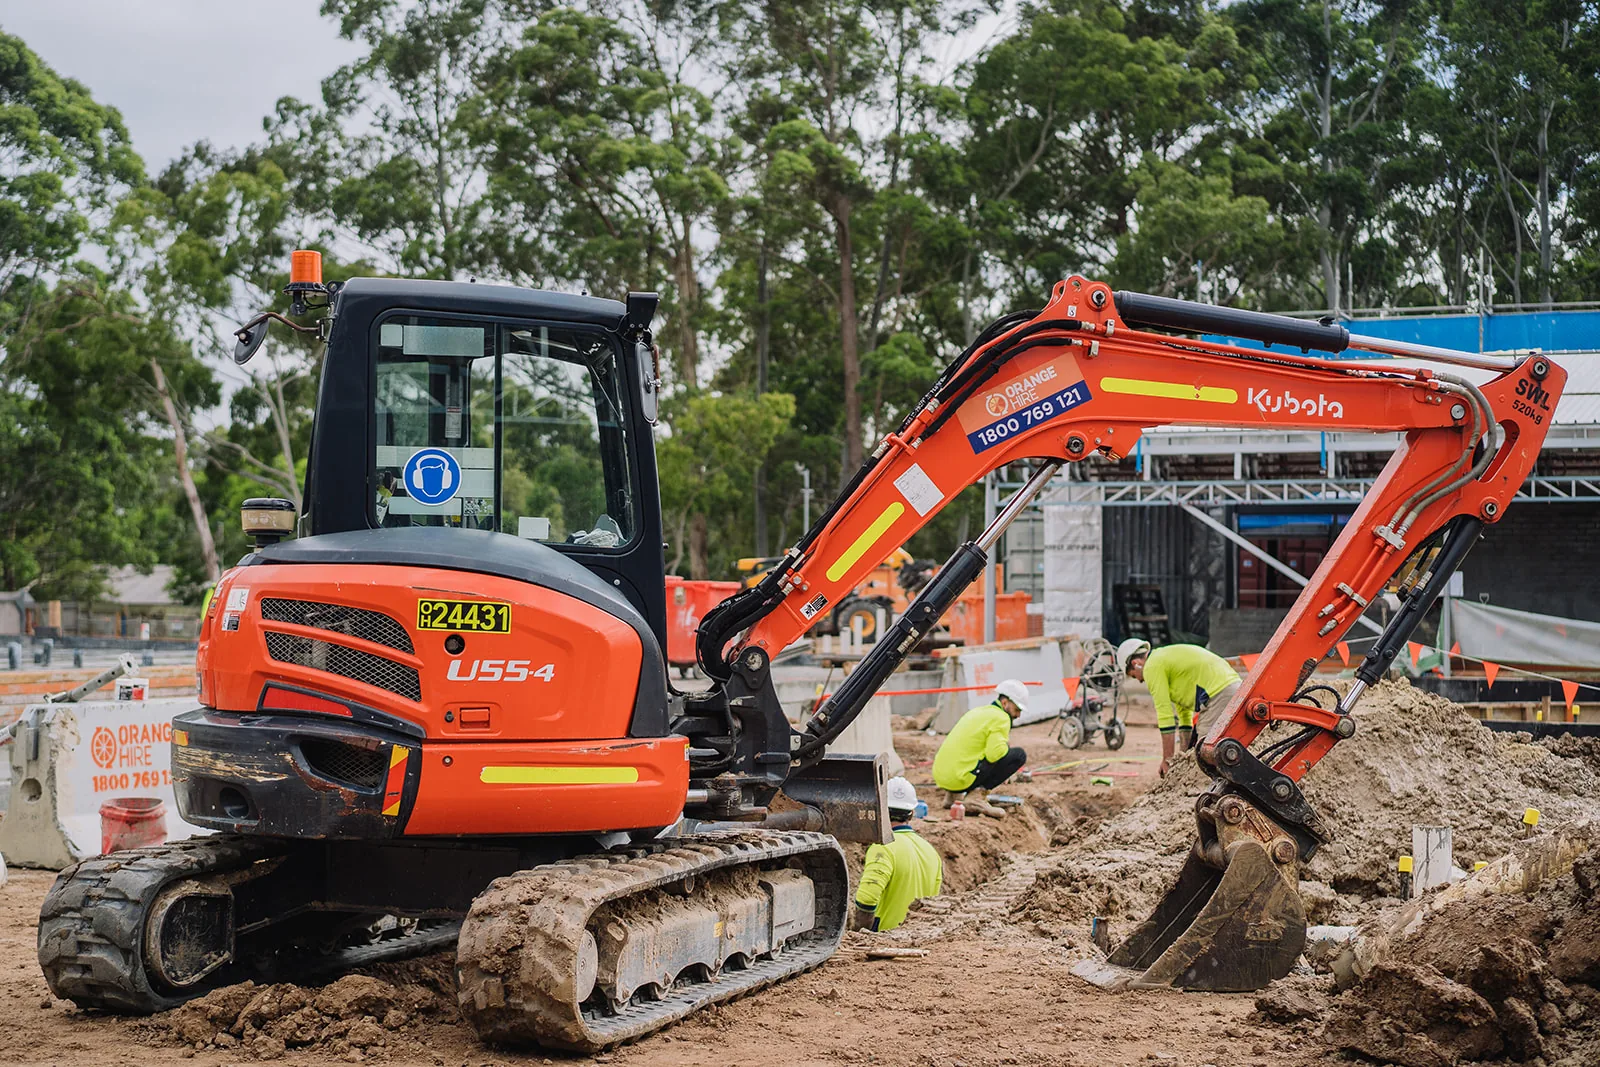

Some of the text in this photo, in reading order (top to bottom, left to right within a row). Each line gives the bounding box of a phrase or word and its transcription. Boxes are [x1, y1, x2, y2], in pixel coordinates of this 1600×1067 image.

[1005, 365, 1058, 398] ORANGE
[1515, 378, 1550, 411] SWL
[1009, 387, 1040, 410] HIRE
[1247, 387, 1344, 419] Kubota
[1512, 399, 1544, 425] 520kg
[978, 387, 1082, 446] 1800 769 121
[432, 602, 509, 631] 24431
[119, 745, 152, 768] HIRE
[92, 769, 173, 793] 1800 769 1
